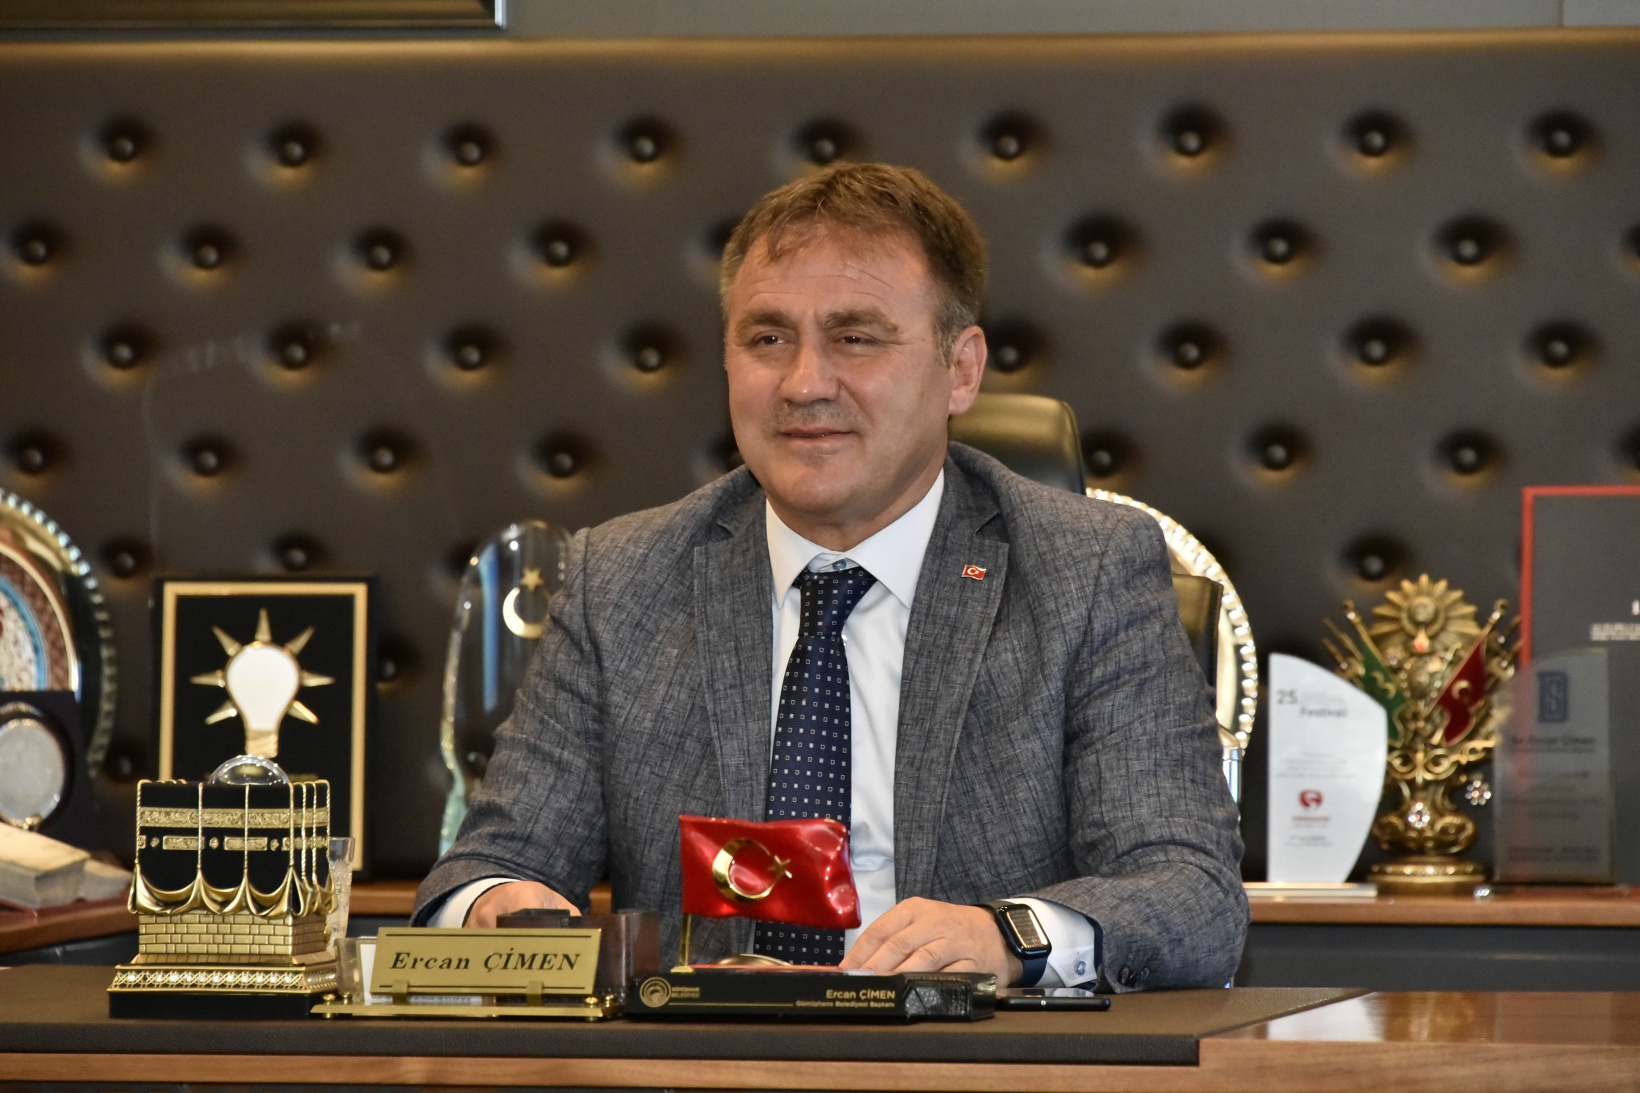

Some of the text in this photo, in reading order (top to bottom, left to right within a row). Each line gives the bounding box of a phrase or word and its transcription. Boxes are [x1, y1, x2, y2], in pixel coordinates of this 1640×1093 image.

[388, 947, 580, 972] Ercan ÇİMEN
[826, 988, 895, 1000] Ercan ÇİMEN
